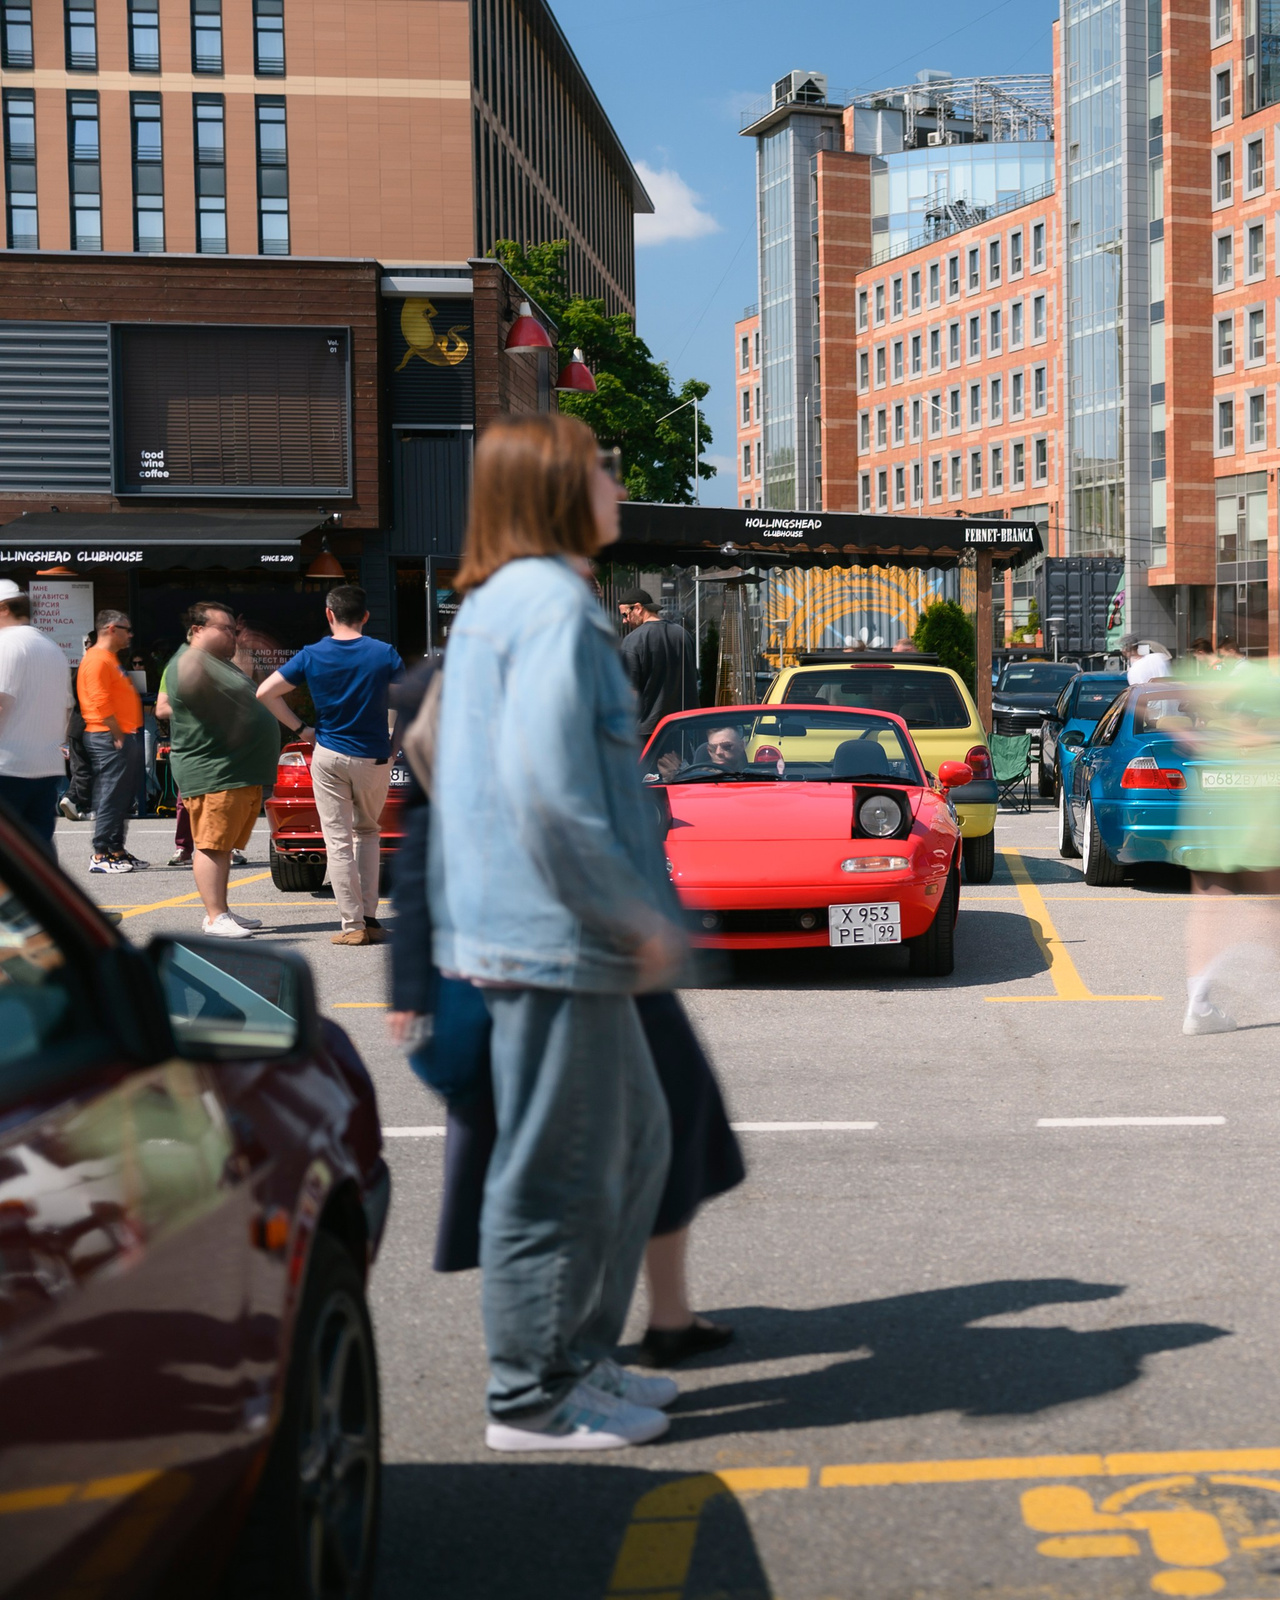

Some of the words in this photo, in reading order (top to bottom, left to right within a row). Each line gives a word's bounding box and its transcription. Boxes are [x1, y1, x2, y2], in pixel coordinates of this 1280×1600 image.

[141, 450, 164, 459] food
[141, 459, 165, 468] wine
[139, 469, 170, 478] coffee
[745, 518, 822, 529] HOLLINGSHEAD
[763, 530, 804, 538] CLUBHOUSE
[965, 528, 1034, 542] FERNET-BRANCA
[0, 551, 71, 563] LLINGSHEAD
[77, 551, 143, 562] CLUBHOUSE
[858, 906, 889, 922] 953
[878, 925, 894, 937] 99
